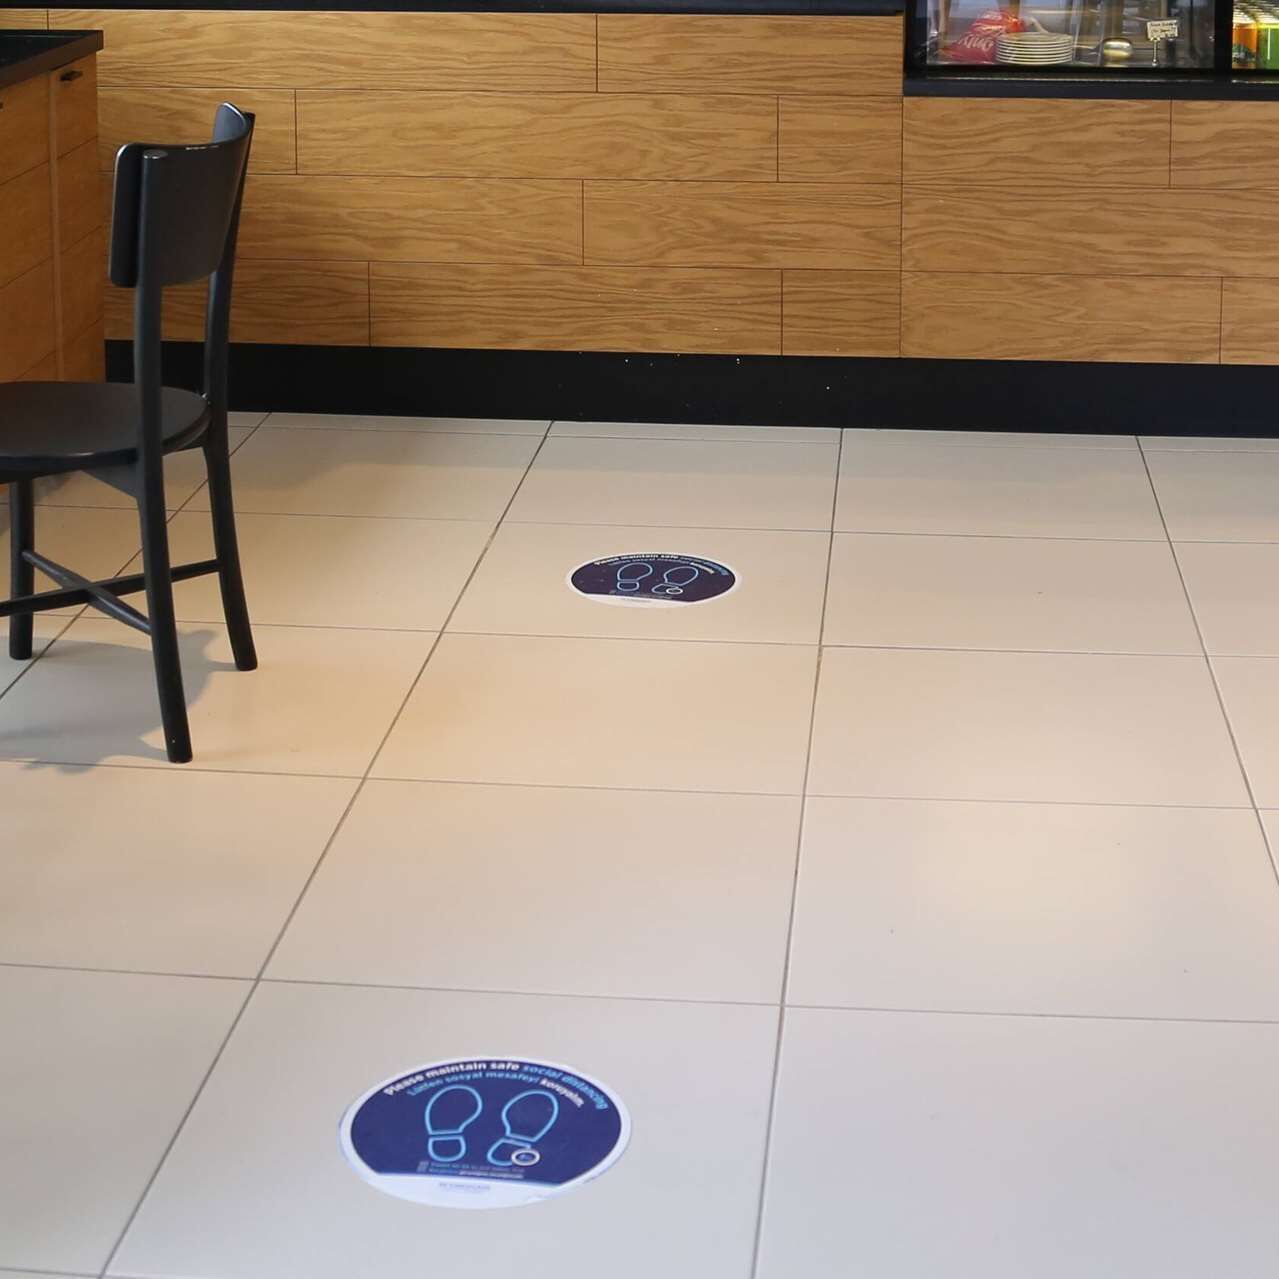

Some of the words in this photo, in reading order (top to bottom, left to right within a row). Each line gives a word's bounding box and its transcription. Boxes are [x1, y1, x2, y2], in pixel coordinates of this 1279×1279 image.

[383, 1074, 424, 1096] Please
[426, 1062, 487, 1079] maintain
[490, 1062, 520, 1071] safe
[521, 1065, 563, 1079] social
[561, 1075, 609, 1110] distancing
